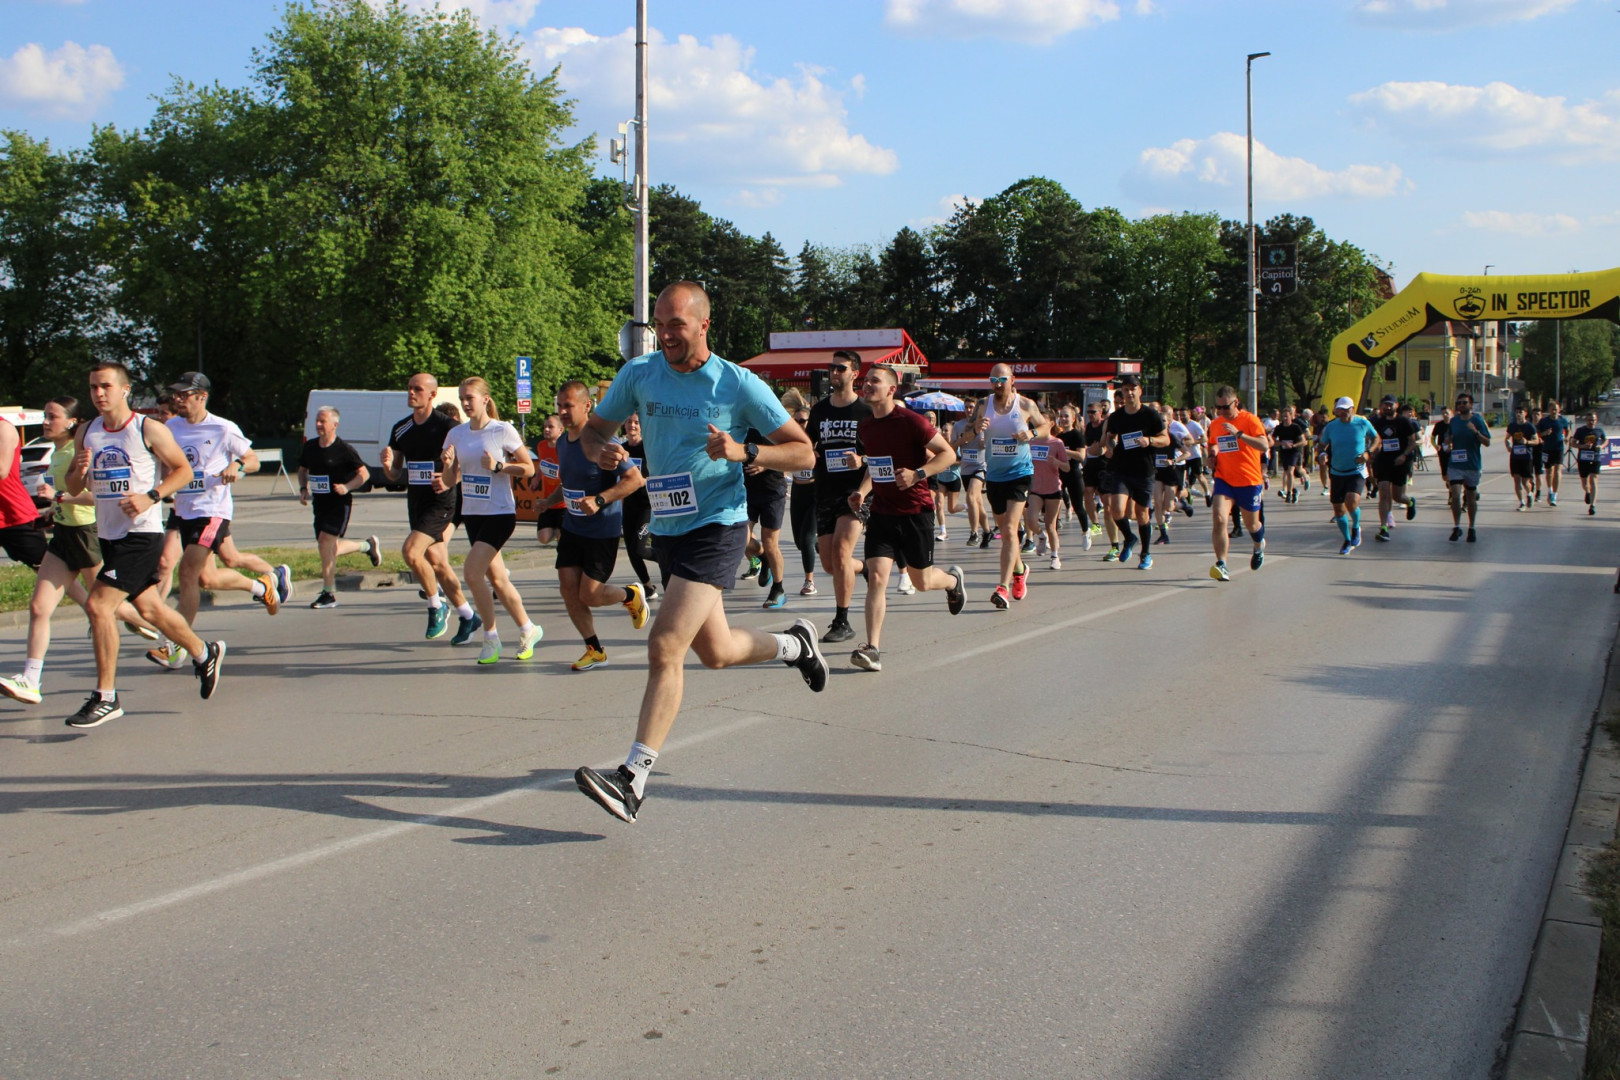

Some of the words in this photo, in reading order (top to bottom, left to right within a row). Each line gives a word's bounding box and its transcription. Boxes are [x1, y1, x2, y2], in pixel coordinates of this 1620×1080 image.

[1261, 270, 1294, 280] Capitol
[654, 402, 700, 419] Funkcija
[706, 406, 720, 419] 13
[1004, 445, 1016, 453] 027
[106, 453, 117, 461] 20
[420, 471, 432, 479] 013
[878, 467, 892, 476] 052
[110, 480, 130, 492] 079
[189, 480, 204, 489] 074
[475, 485, 489, 494] 007
[667, 490, 691, 507] 102
